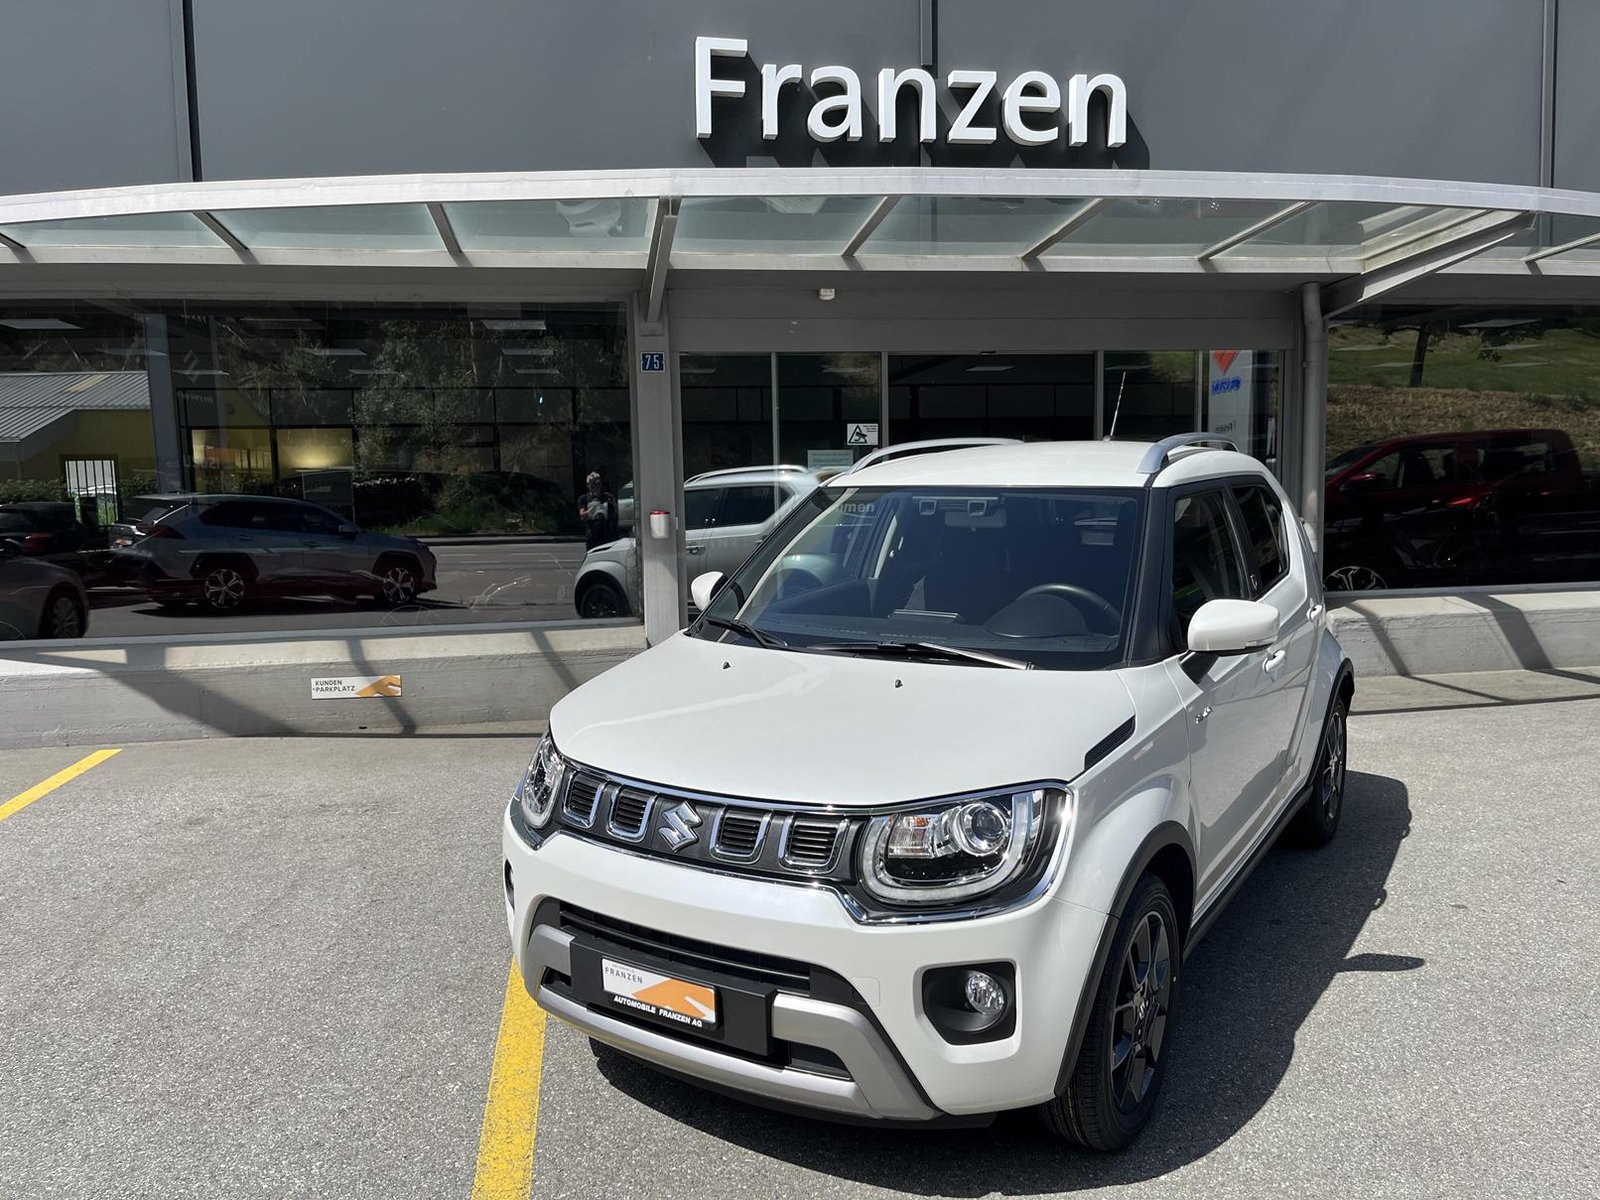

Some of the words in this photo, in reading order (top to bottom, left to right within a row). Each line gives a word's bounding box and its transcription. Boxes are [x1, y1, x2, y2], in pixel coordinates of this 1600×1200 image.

[694, 36, 1127, 148] Franzen
[645, 354, 660, 369] 75
[604, 966, 643, 983] FRANZEN
[614, 996, 656, 1013] AUTOMOBILE
[659, 1009, 690, 1023] FRANZEN
[692, 1017, 703, 1027] AG
